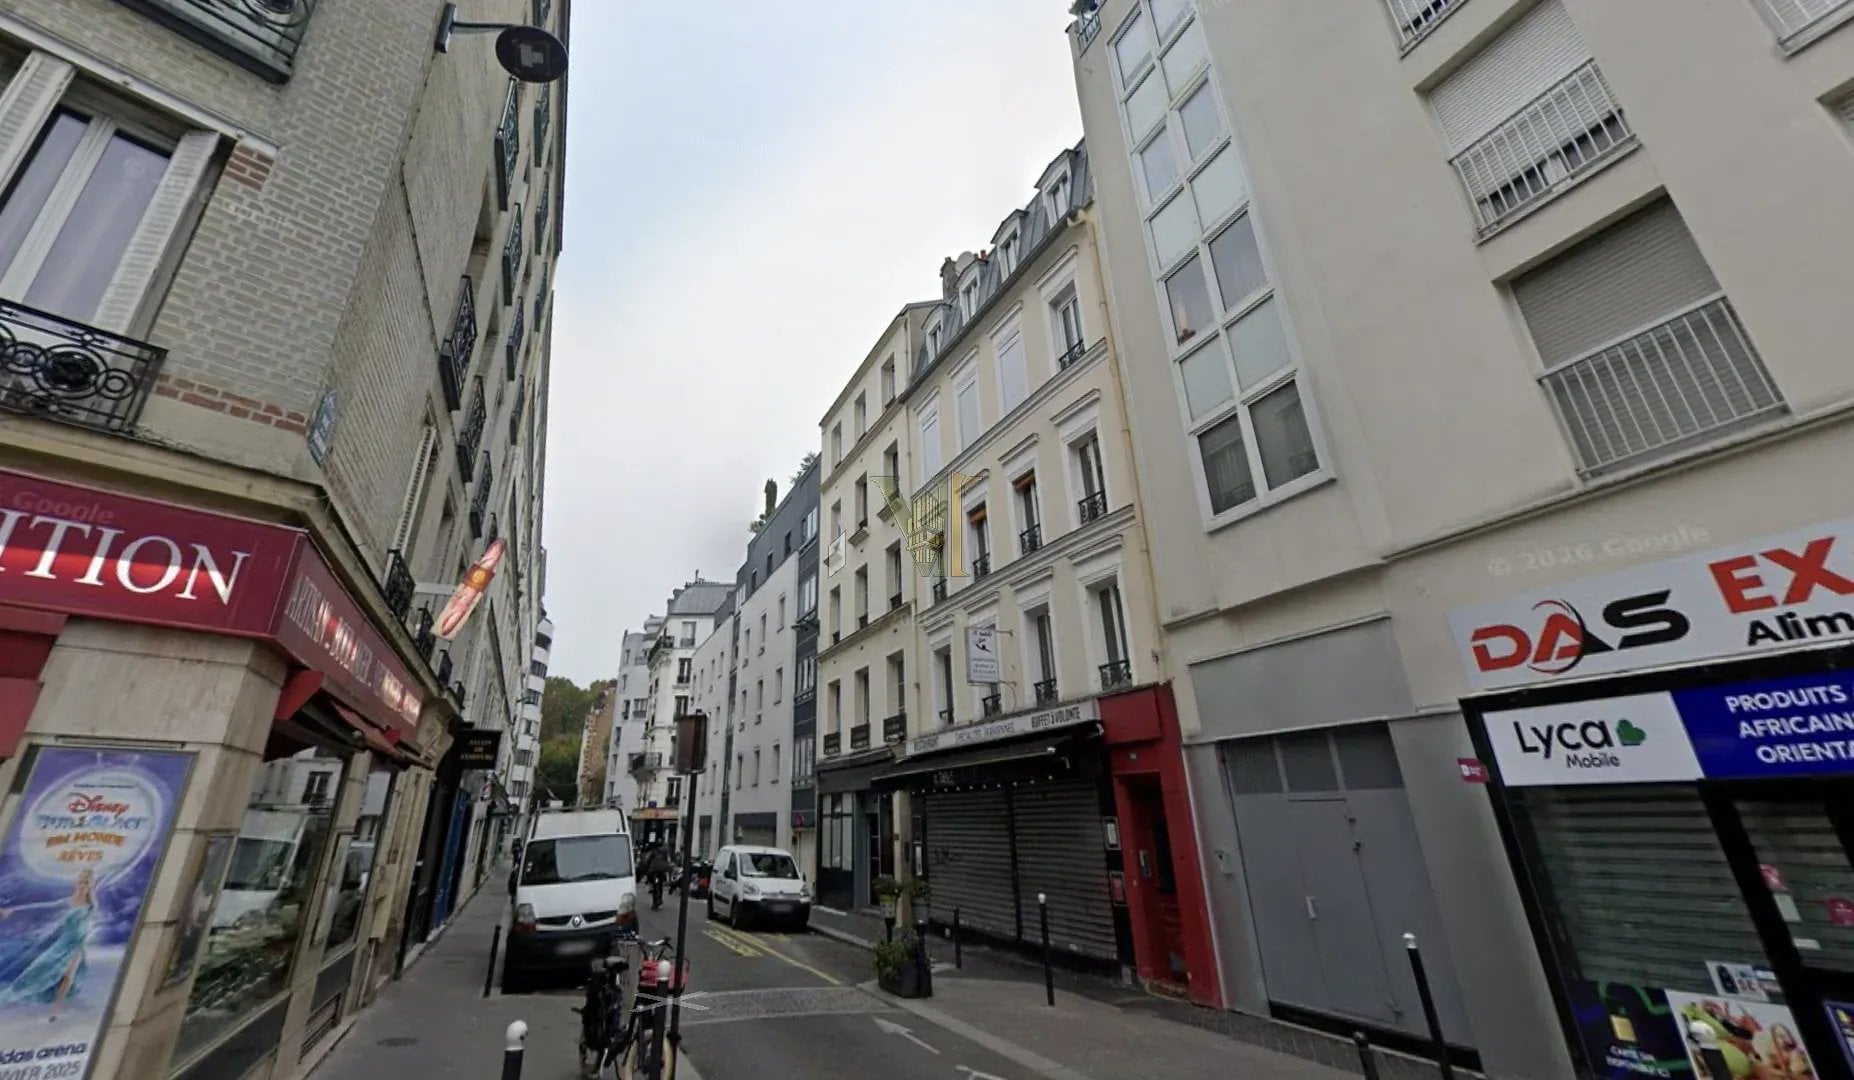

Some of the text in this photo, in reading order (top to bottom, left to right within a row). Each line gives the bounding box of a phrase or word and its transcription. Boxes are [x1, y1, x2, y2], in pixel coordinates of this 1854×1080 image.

[1471, 536, 1854, 674] DAS EX
[1724, 684, 1848, 713] PRODUITS
[1739, 711, 1854, 739] AFRICAIN
[1513, 719, 1614, 759] Lyca
[1566, 752, 1621, 769] Mobile
[67, 791, 130, 818] Disney
[36, 1042, 88, 1060] arena
[44, 1060, 80, 1080] 2025
